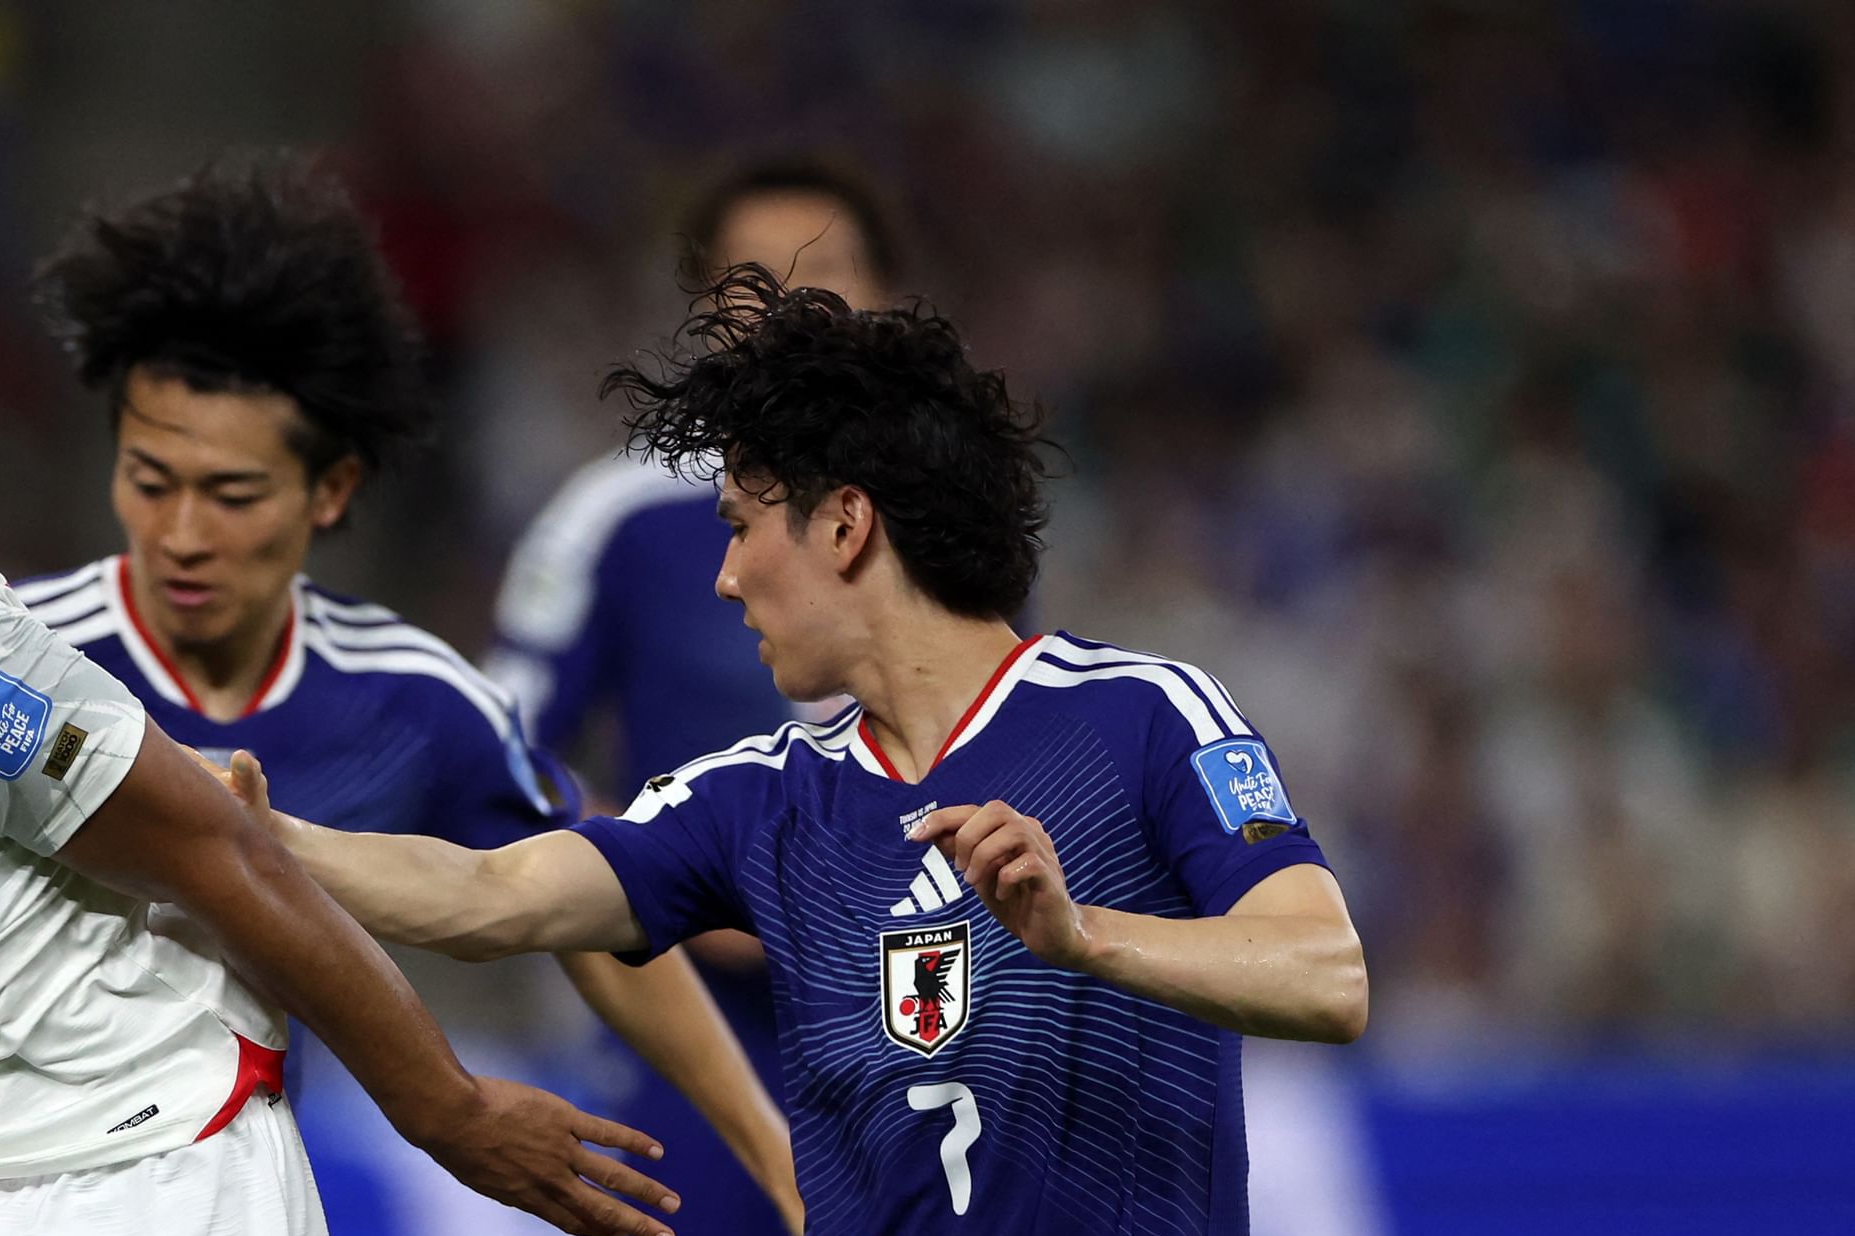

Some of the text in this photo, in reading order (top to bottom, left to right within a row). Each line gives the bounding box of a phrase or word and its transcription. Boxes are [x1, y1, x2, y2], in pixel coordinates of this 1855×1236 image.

[2, 701, 18, 724] For
[0, 710, 30, 755] PEACE
[20, 729, 35, 753] FIFA
[1229, 776, 1258, 795] Unite
[906, 931, 952, 946] JAPAN
[910, 1012, 948, 1035] JFA
[907, 1081, 982, 1216] 7
